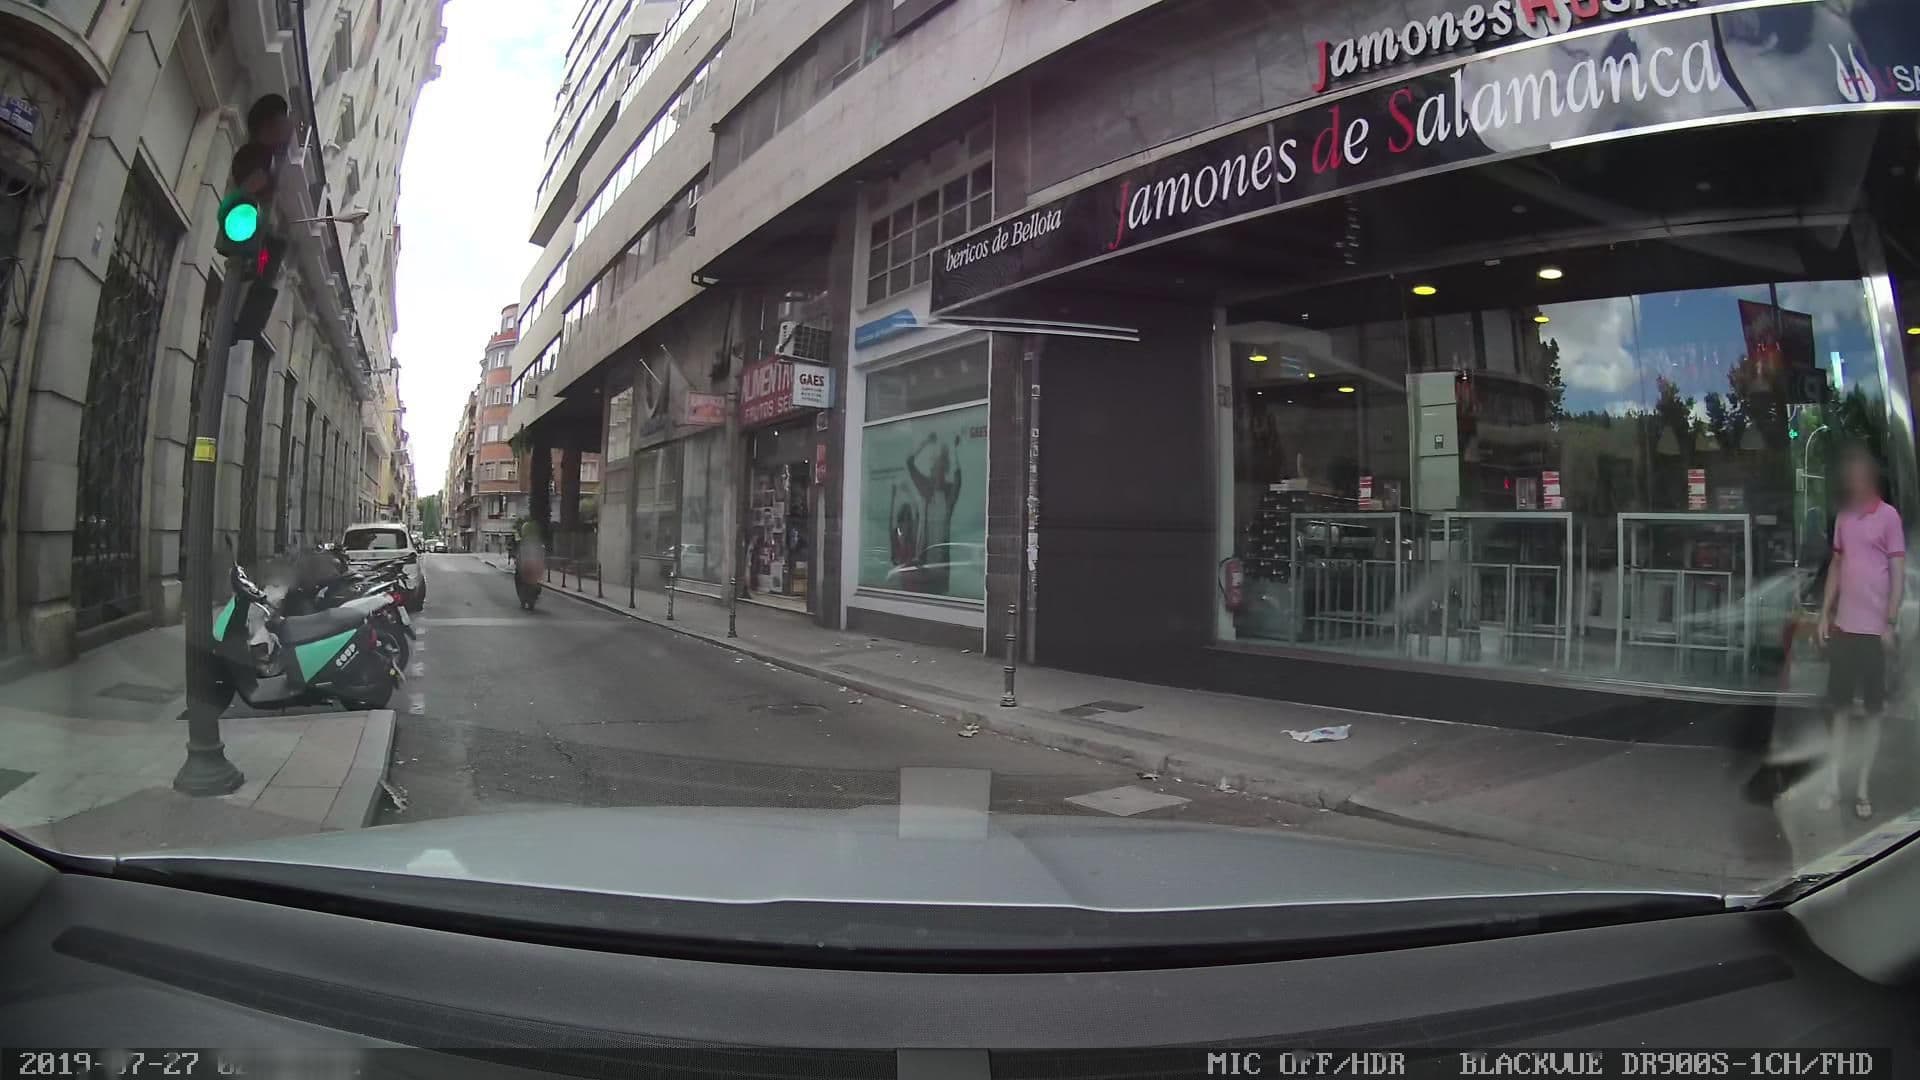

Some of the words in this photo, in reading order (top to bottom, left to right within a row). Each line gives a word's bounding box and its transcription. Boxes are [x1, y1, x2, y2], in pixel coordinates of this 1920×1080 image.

[1312, 2, 1514, 93] Jamones
[1108, 139, 1297, 250] Jamones
[1312, 105, 1369, 174] de
[1388, 39, 1723, 154] Salamanca
[992, 226, 1010, 254] de
[1010, 209, 1062, 247] Bellota
[799, 373, 825, 387] GAES
